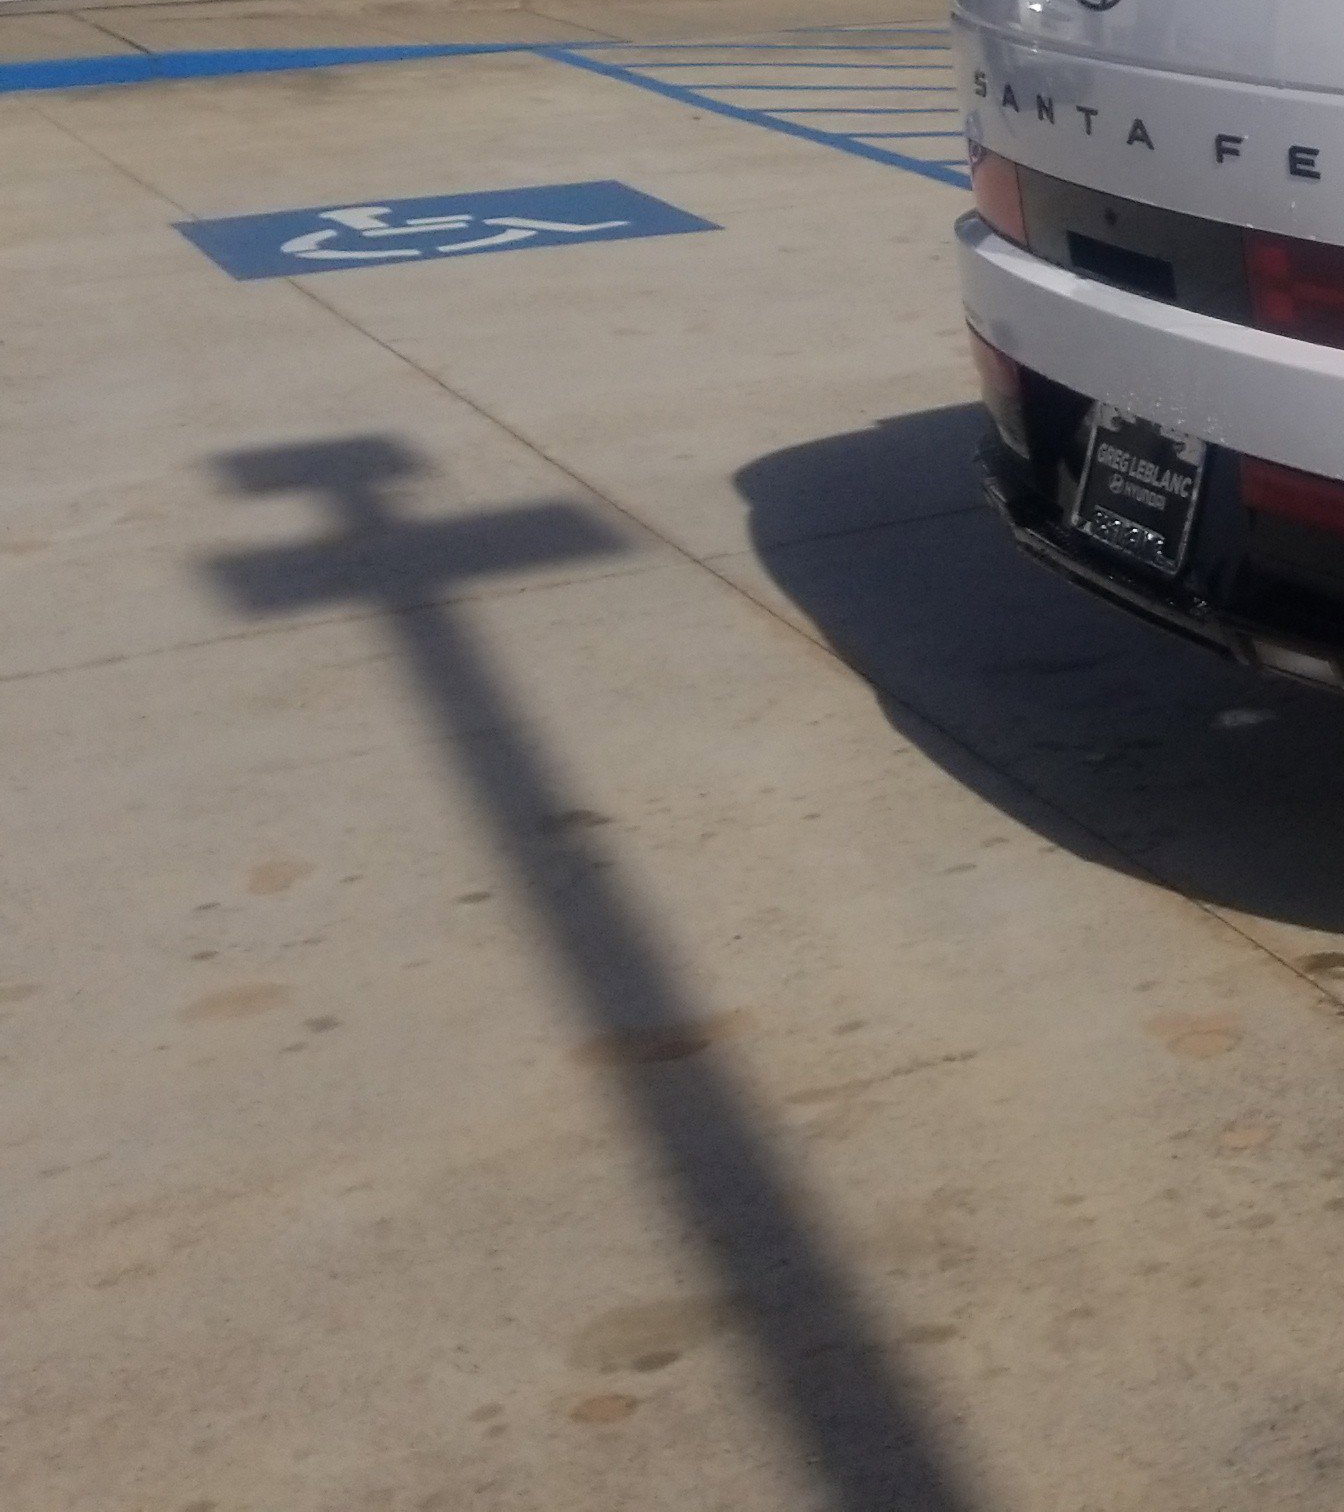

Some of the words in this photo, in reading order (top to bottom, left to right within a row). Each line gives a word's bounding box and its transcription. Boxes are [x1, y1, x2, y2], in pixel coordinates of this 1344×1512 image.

[975, 72, 1155, 150] SANTA
[1215, 133, 1321, 180] FE
[1128, 457, 1192, 498] LEBLANC
